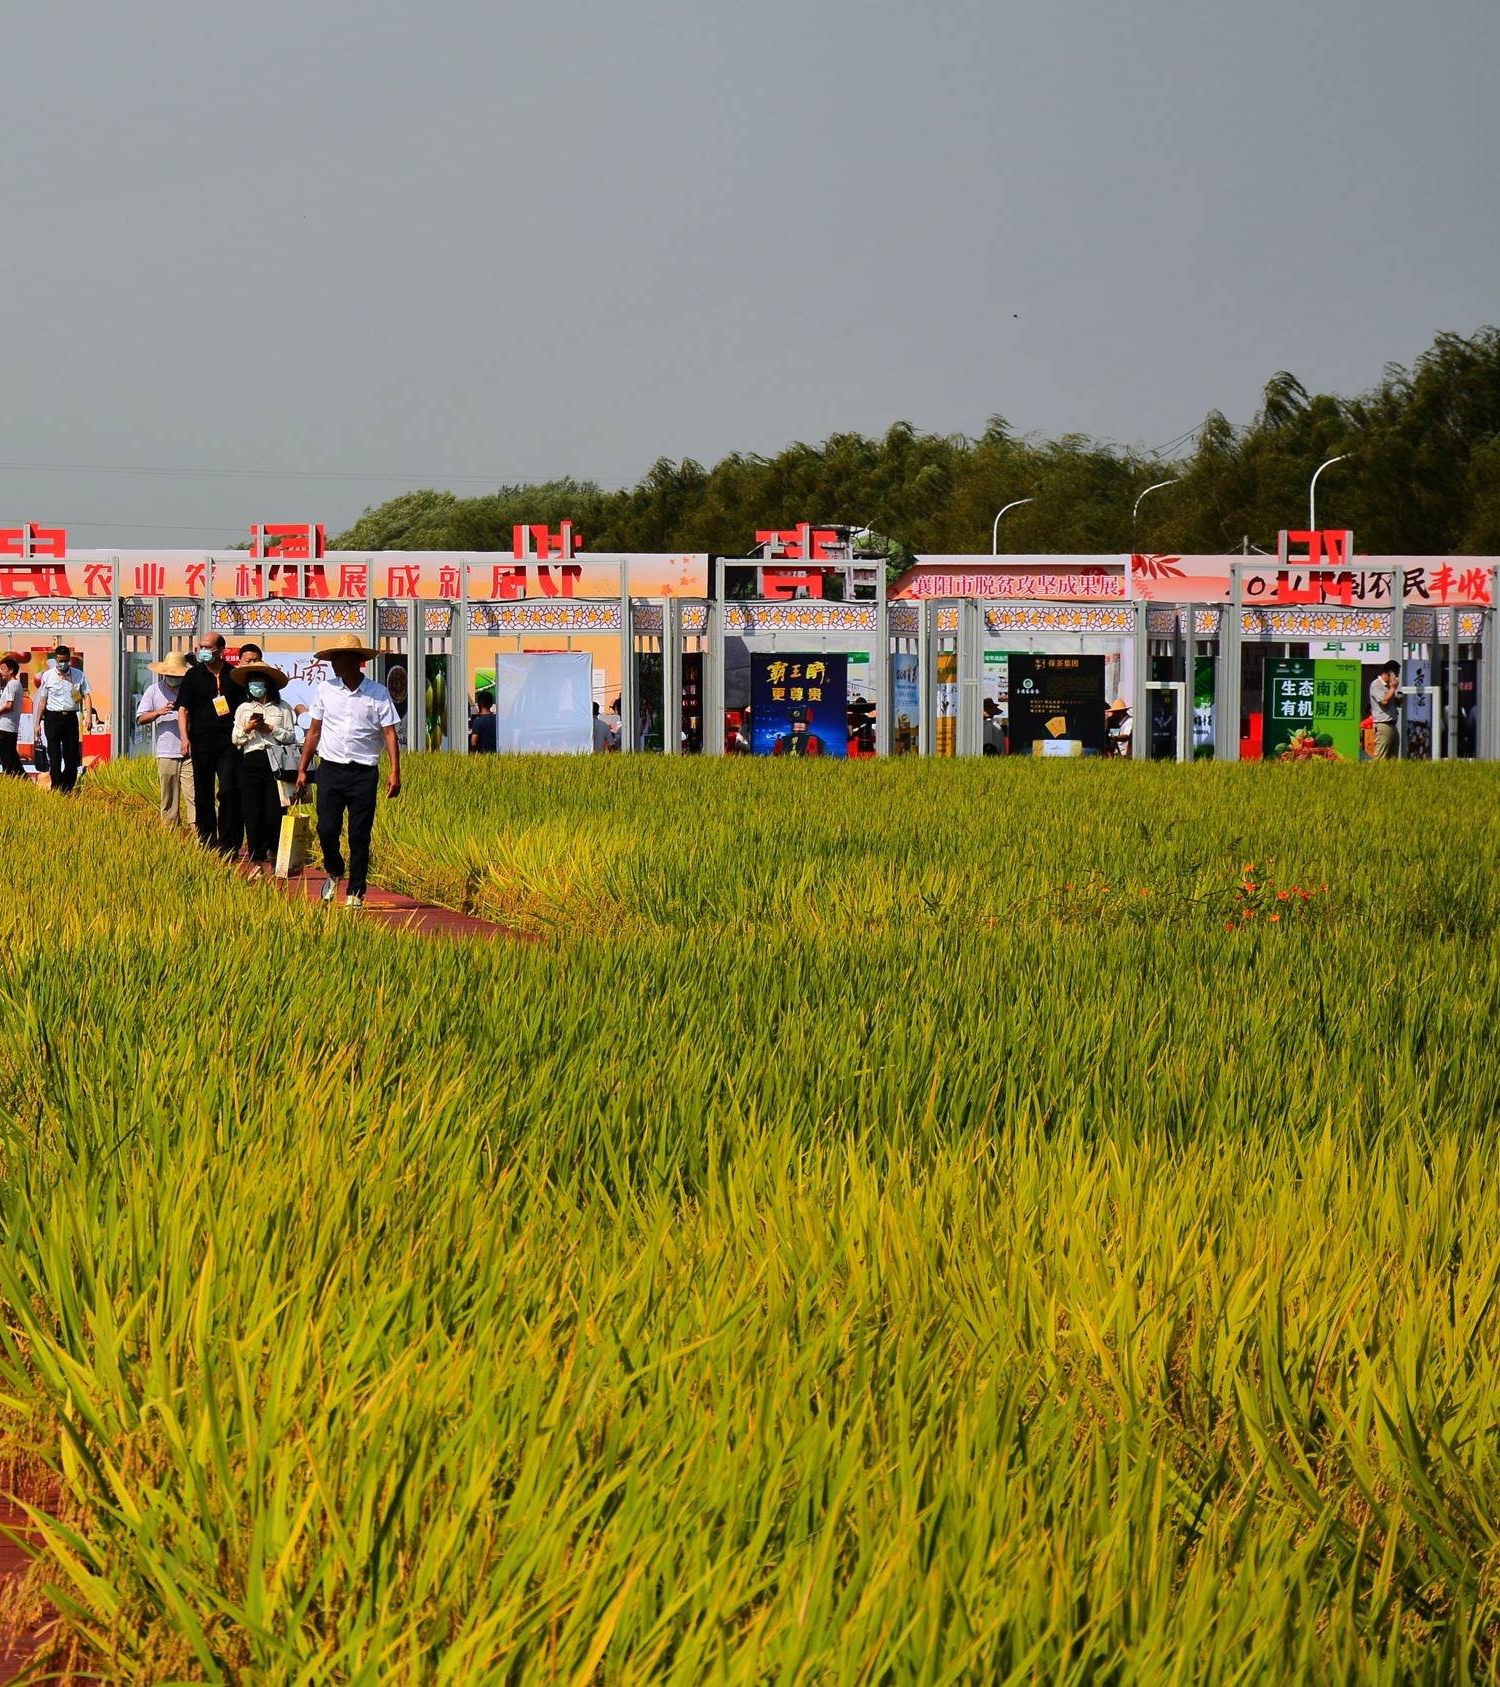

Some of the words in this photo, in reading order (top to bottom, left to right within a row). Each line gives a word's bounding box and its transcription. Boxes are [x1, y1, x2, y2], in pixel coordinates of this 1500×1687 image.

[912, 574, 1119, 596] 襄阳市脱贫攻坚成果展
[274, 658, 328, 687] 山药
[772, 687, 822, 702] 更尊贵
[1281, 680, 1348, 697] 生态南漳
[1281, 701, 1348, 717] 有机厨房
